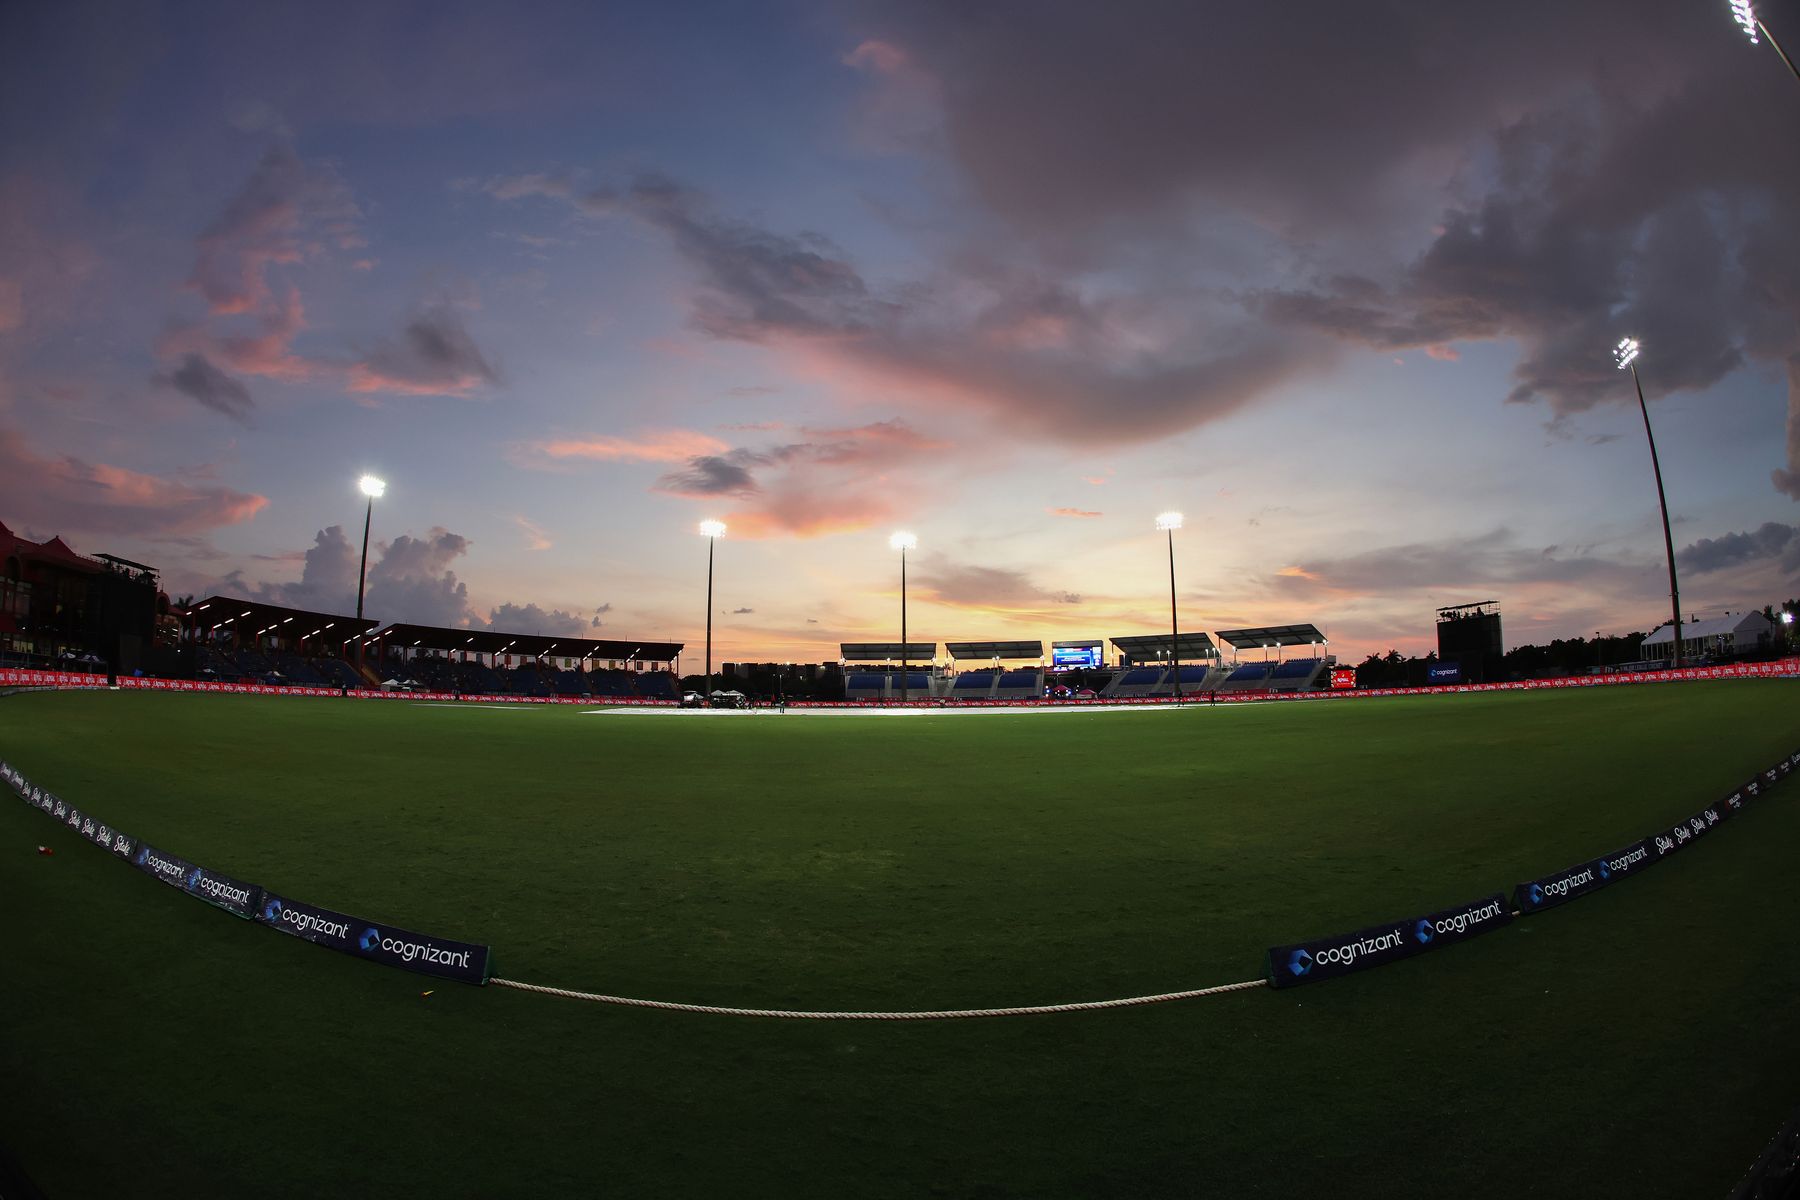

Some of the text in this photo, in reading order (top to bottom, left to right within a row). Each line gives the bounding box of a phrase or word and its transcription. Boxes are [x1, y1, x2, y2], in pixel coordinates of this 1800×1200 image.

[69, 810, 81, 829] Stake
[81, 818, 95, 838] Stake
[96, 826, 112, 847] Stake
[113, 835, 131, 857] Stake
[1655, 837, 1674, 855] Stake
[1675, 826, 1691, 844] Stake
[147, 854, 185, 879] cognizant
[1609, 846, 1648, 871] cognizant
[200, 875, 250, 904] cognizant
[1544, 868, 1594, 896] cognizant
[282, 908, 349, 939] cognizant
[1435, 900, 1502, 934] cognizant
[382, 937, 470, 969] cognizant
[1316, 929, 1403, 966] cognizant
